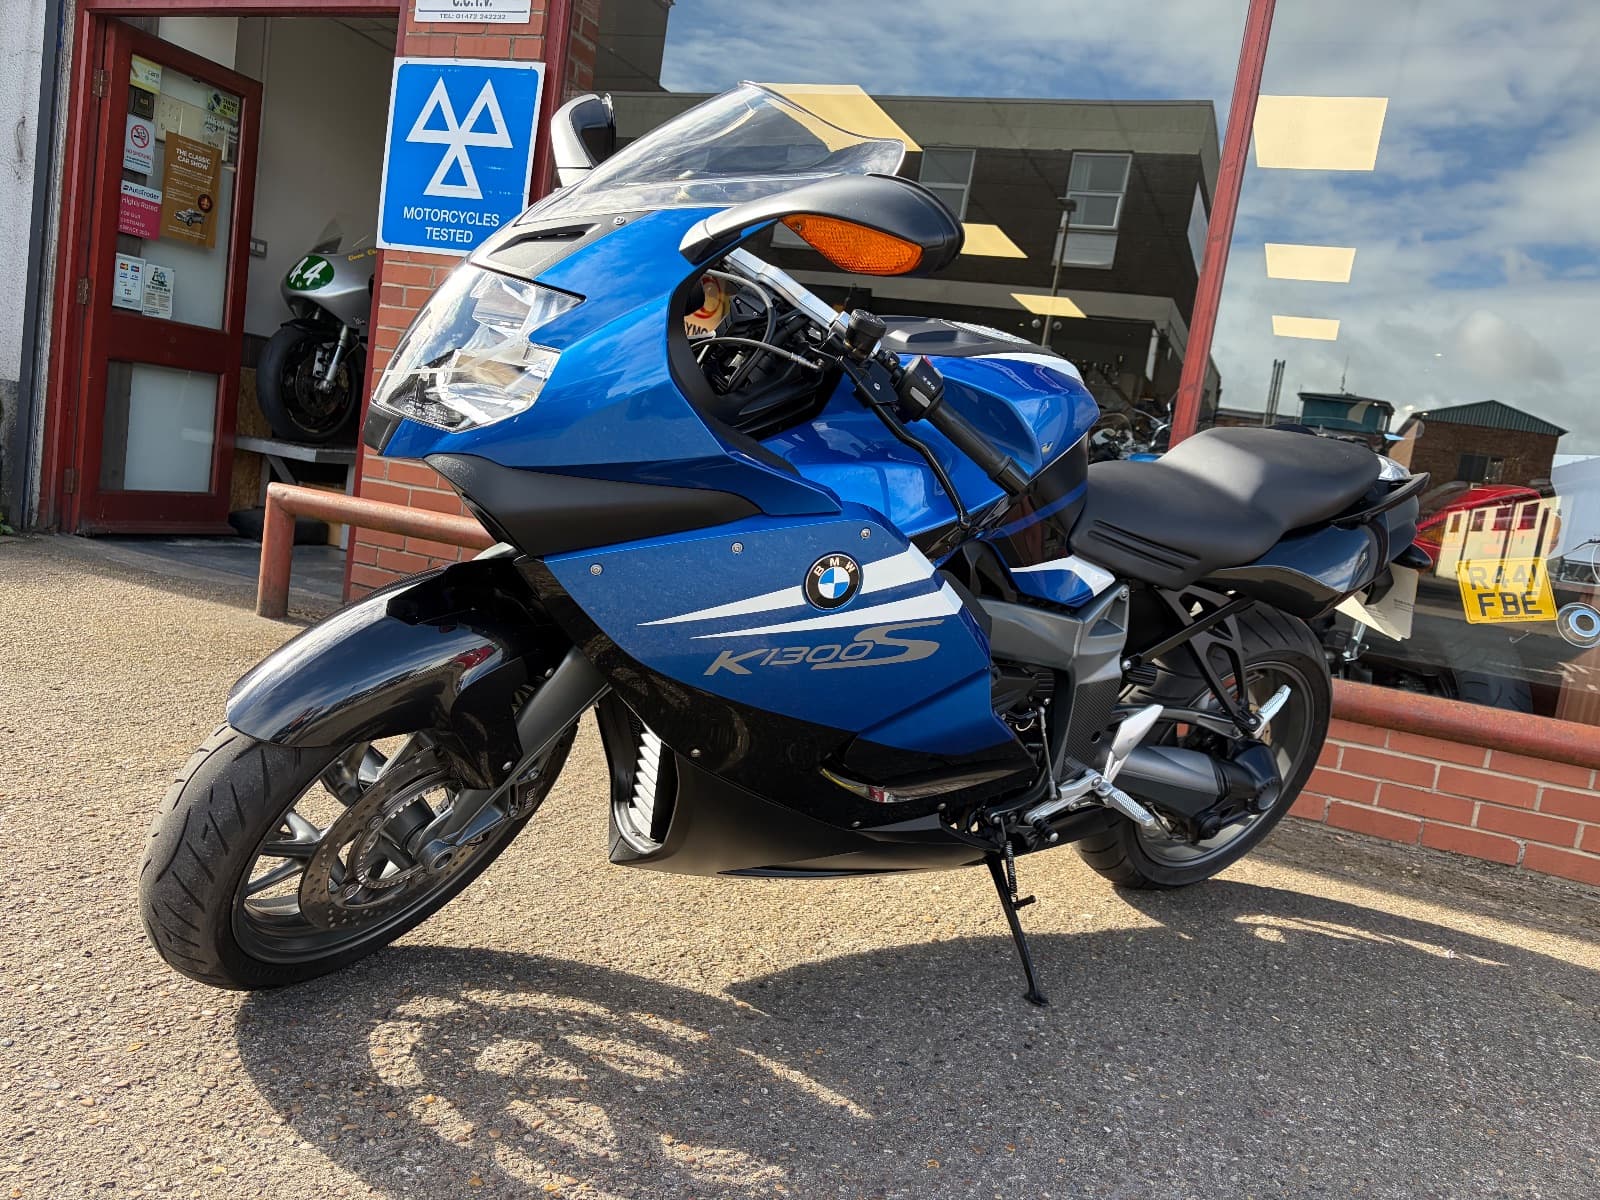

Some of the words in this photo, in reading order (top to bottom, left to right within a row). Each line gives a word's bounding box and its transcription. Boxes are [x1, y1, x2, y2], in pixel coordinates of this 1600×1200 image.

[176, 148, 187, 157] THE
[188, 152, 211, 164] CLASSIC
[177, 156, 190, 164] CAR
[190, 160, 209, 171] SHOW
[403, 206, 500, 227] MOTORCYCLES
[425, 226, 474, 244] TESTED
[813, 557, 855, 577] BMW
[1477, 591, 1544, 617] FBE
